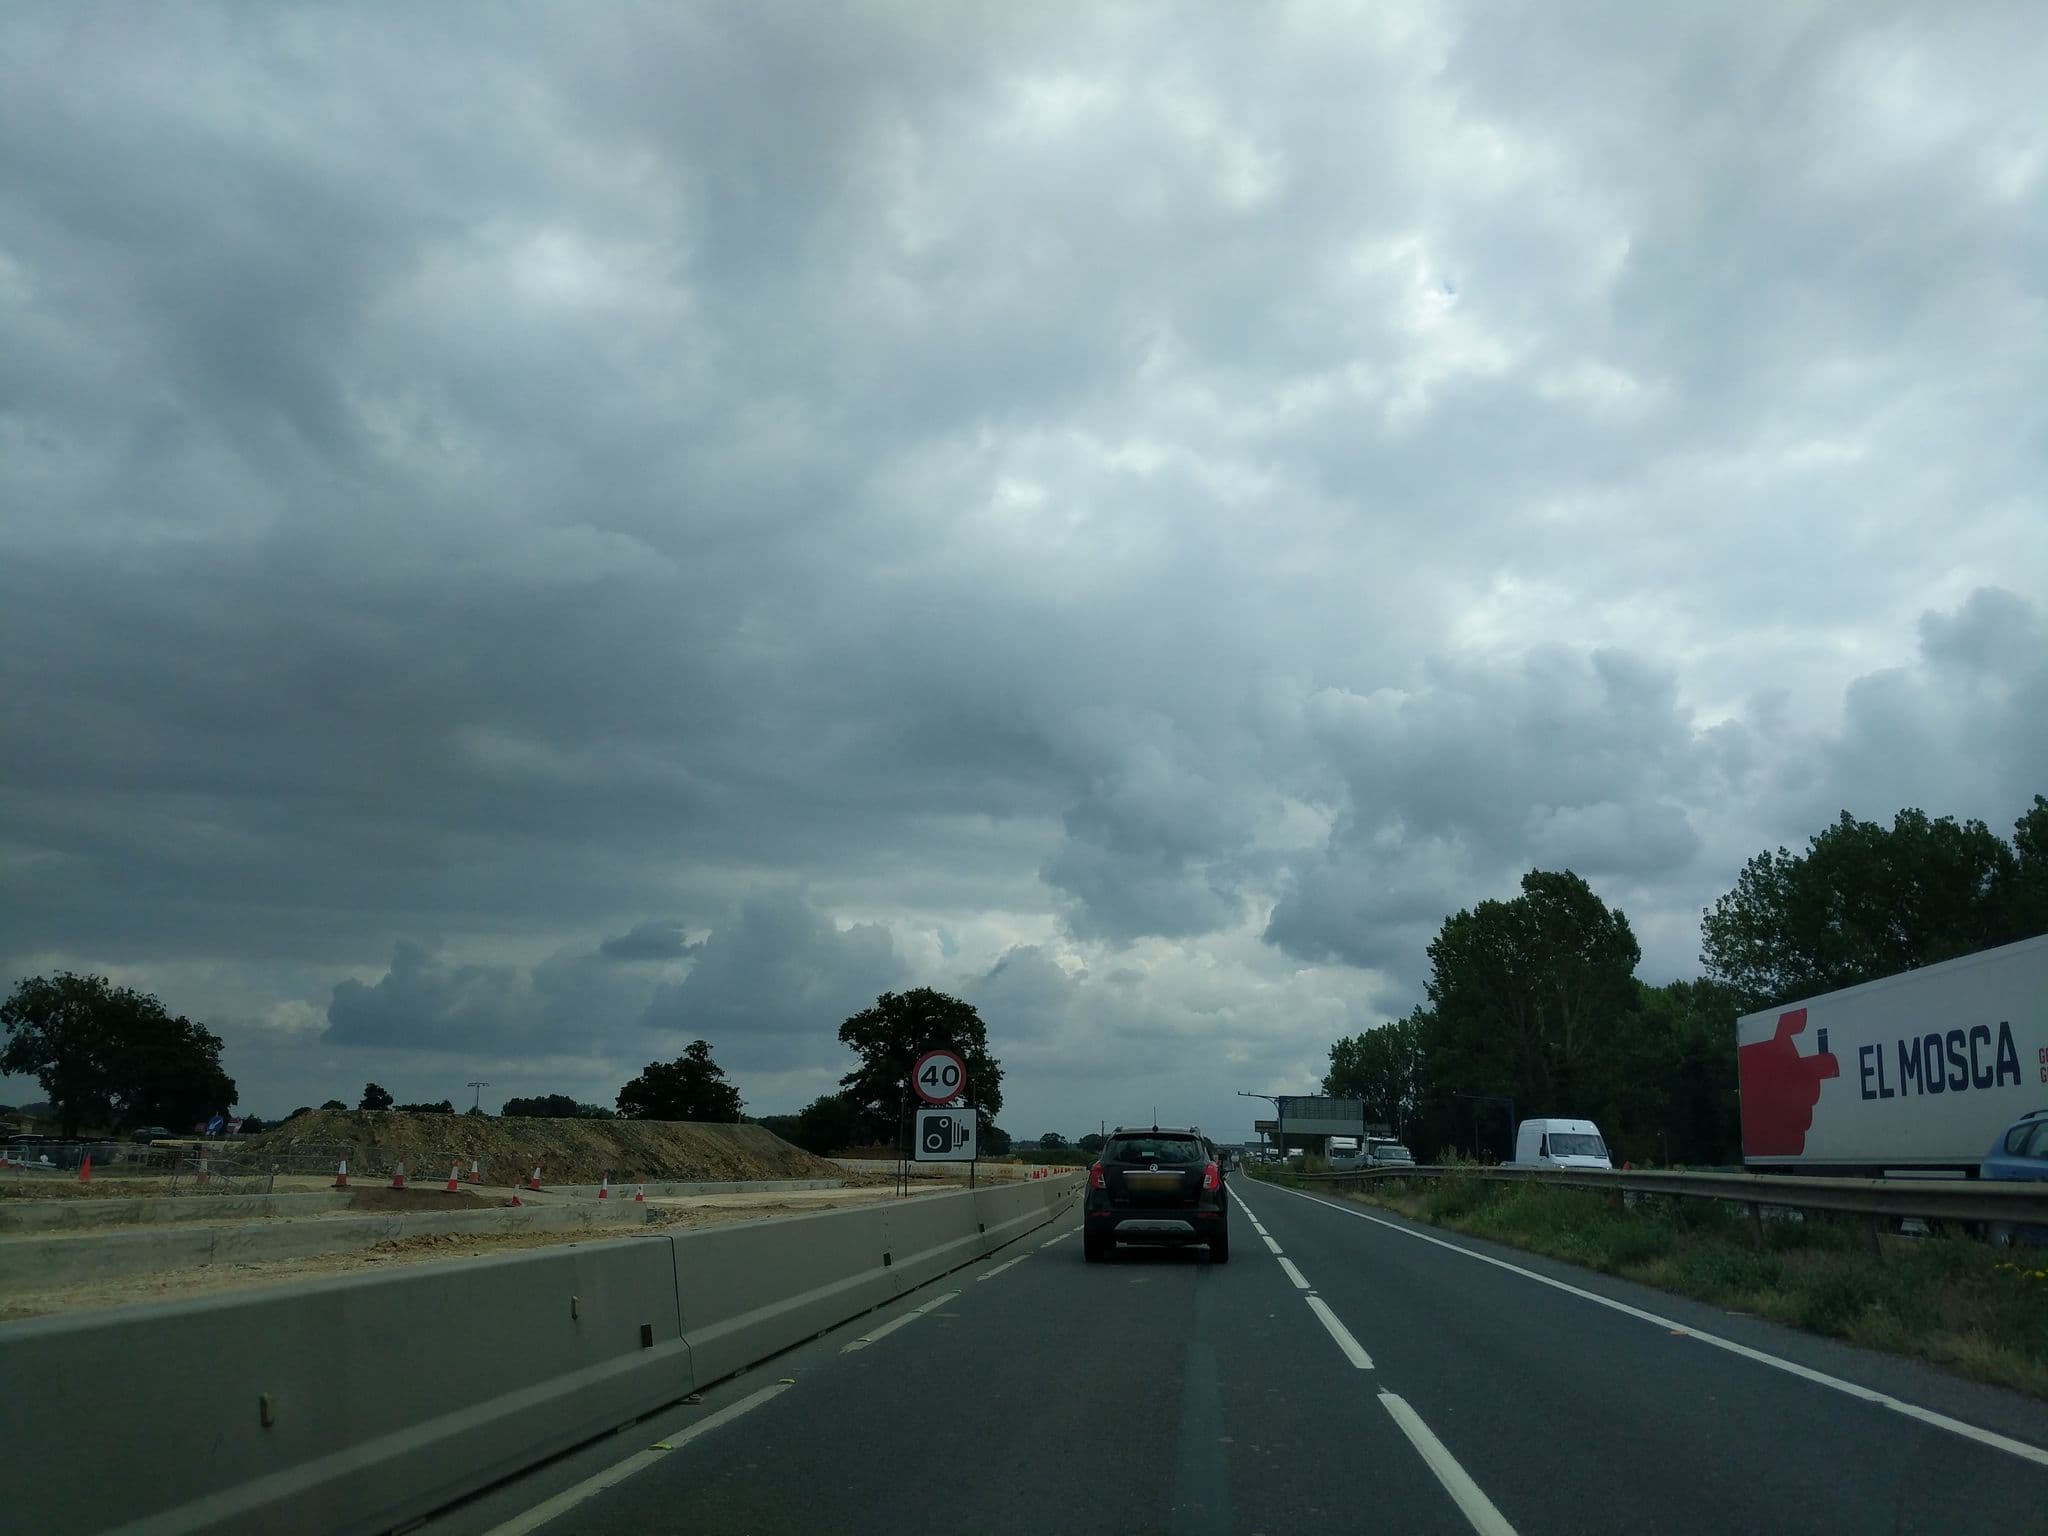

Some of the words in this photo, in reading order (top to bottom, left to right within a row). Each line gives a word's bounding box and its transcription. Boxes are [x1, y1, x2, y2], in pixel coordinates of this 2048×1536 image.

[920, 1065, 960, 1086] 40
[1859, 1044, 1895, 1101] EL
[1898, 1021, 2022, 1097] MOSCA
